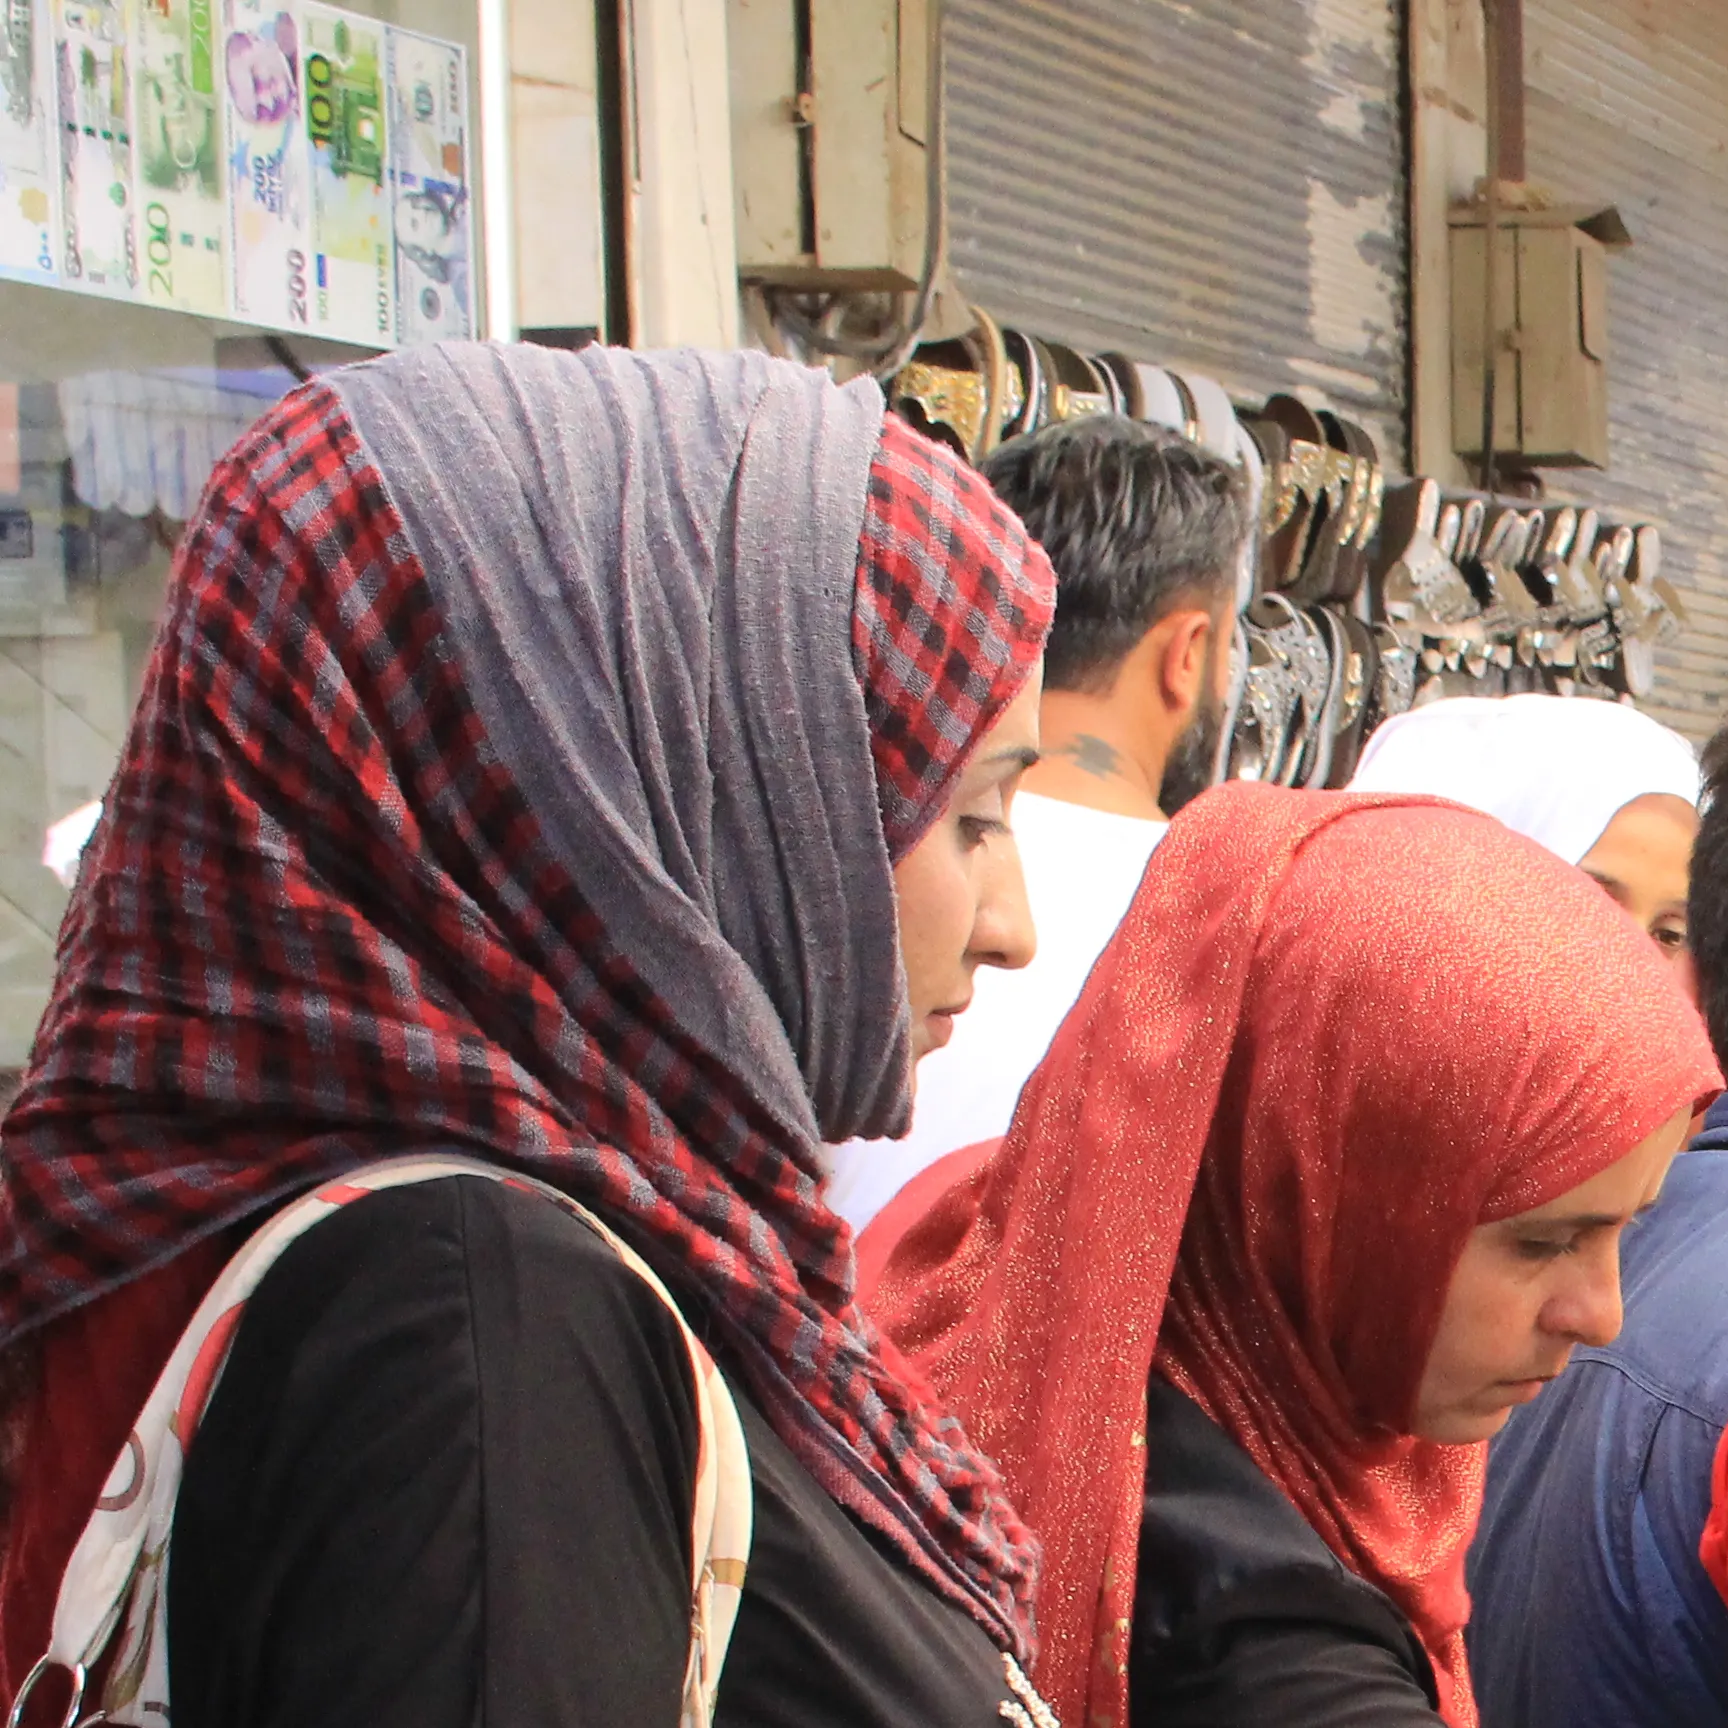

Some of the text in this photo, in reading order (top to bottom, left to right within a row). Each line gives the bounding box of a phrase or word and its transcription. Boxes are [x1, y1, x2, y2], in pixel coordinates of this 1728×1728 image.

[308, 52, 334, 150] 100
[147, 202, 174, 297] 200
[286, 248, 309, 325] 200
